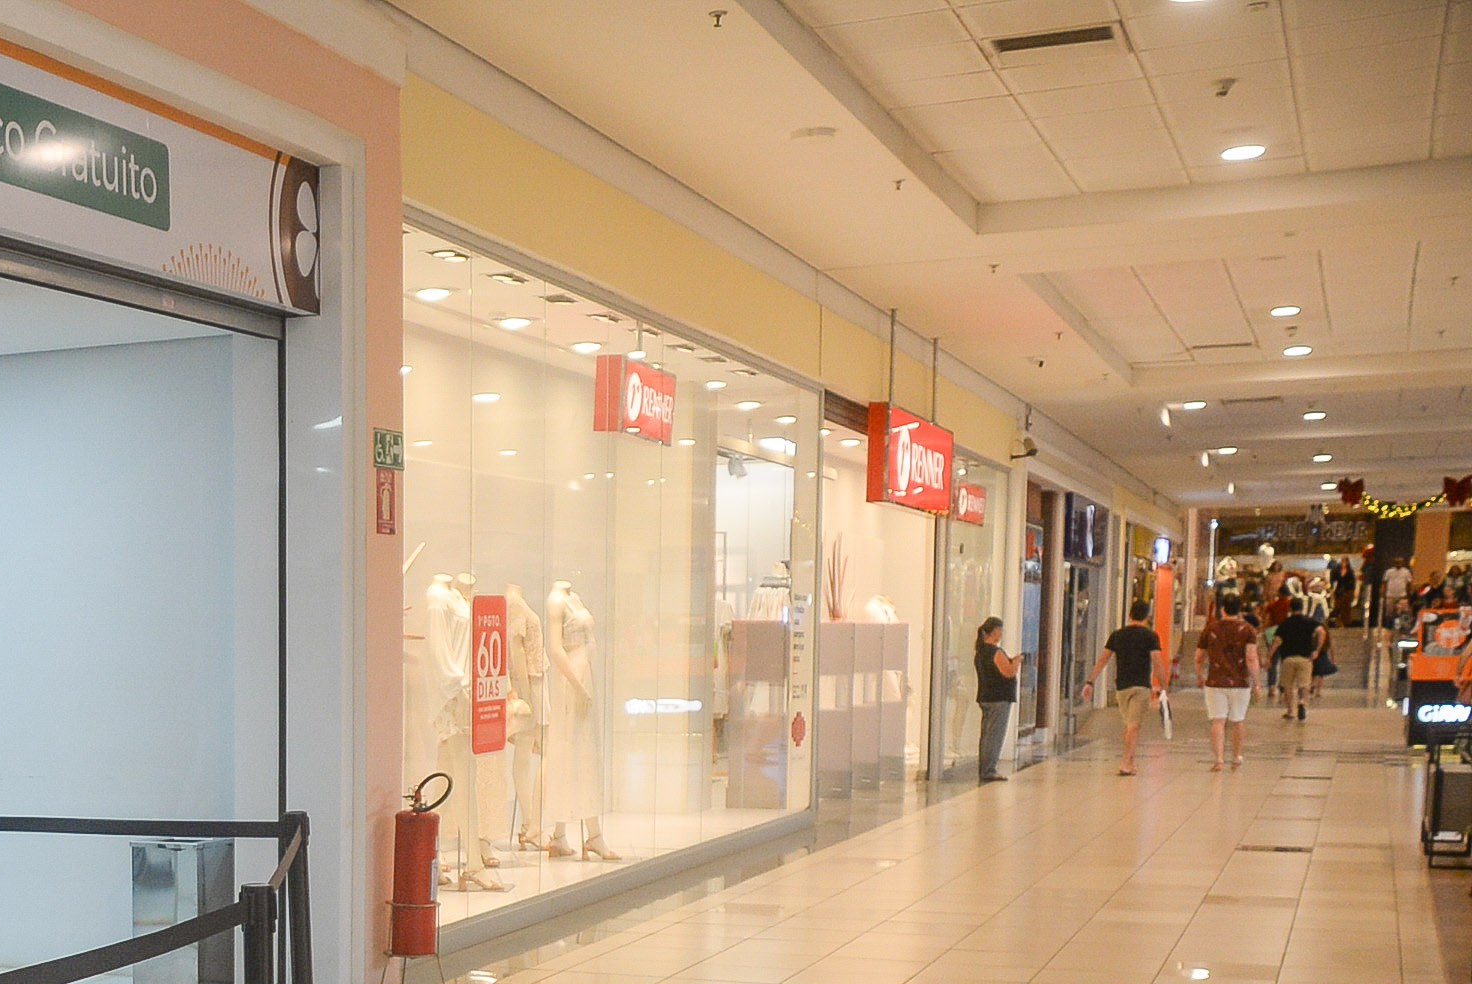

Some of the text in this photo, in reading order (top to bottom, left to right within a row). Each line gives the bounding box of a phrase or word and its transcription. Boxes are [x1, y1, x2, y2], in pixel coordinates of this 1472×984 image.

[35, 119, 158, 204] Gatuito
[910, 441, 945, 490] RENNER
[477, 630, 502, 678] 60
[479, 680, 500, 698] DIAS
